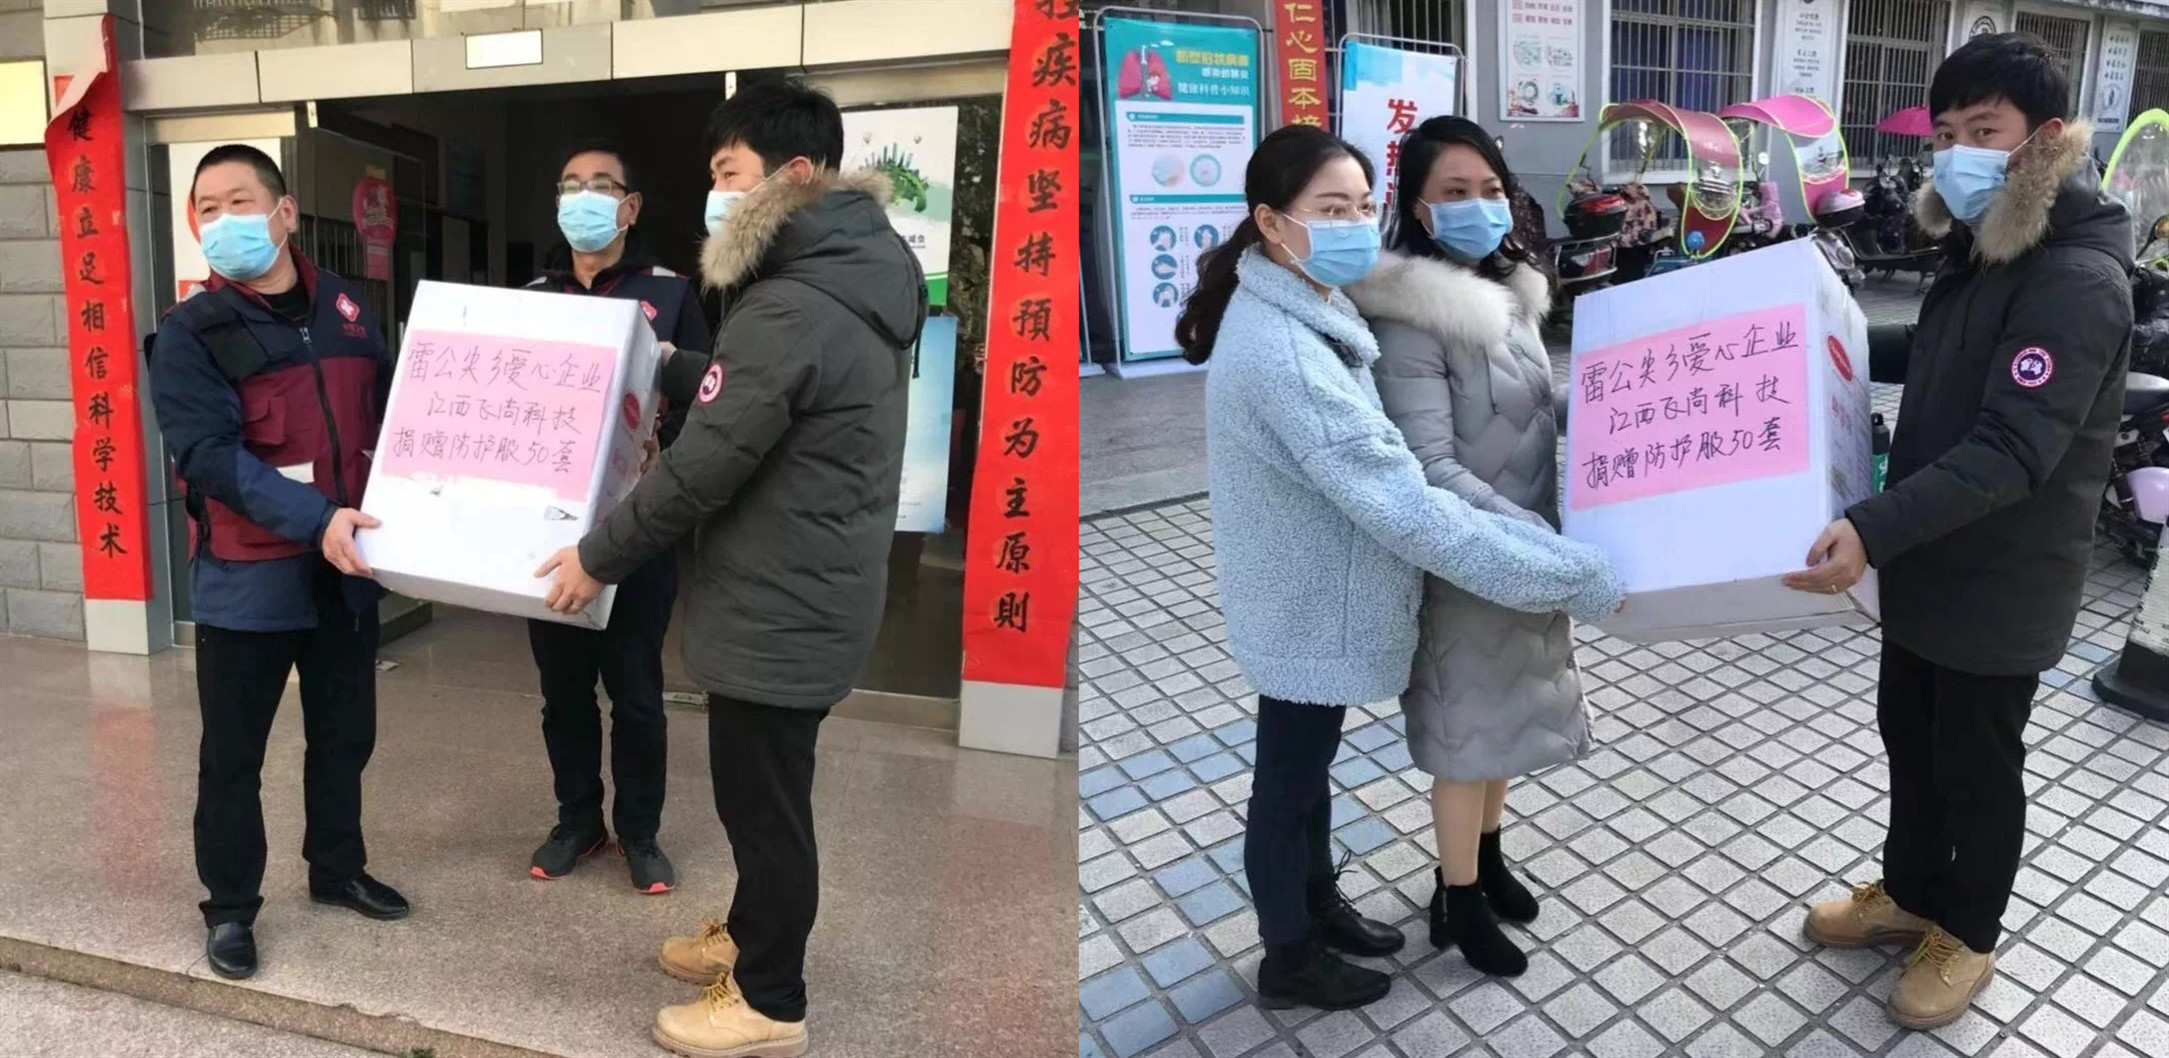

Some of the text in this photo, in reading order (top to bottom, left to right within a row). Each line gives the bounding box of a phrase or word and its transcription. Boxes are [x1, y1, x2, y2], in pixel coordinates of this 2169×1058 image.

[67, 103, 128, 559] 健康立足相信科学技术
[407, 342, 602, 393] 雷公尖乡爱心企业
[1581, 322, 1799, 404] 雷公尖乡爱心企业
[392, 426, 576, 474] 捐赠防护服50套
[1582, 416, 1781, 489] 捐赠防护服50套
